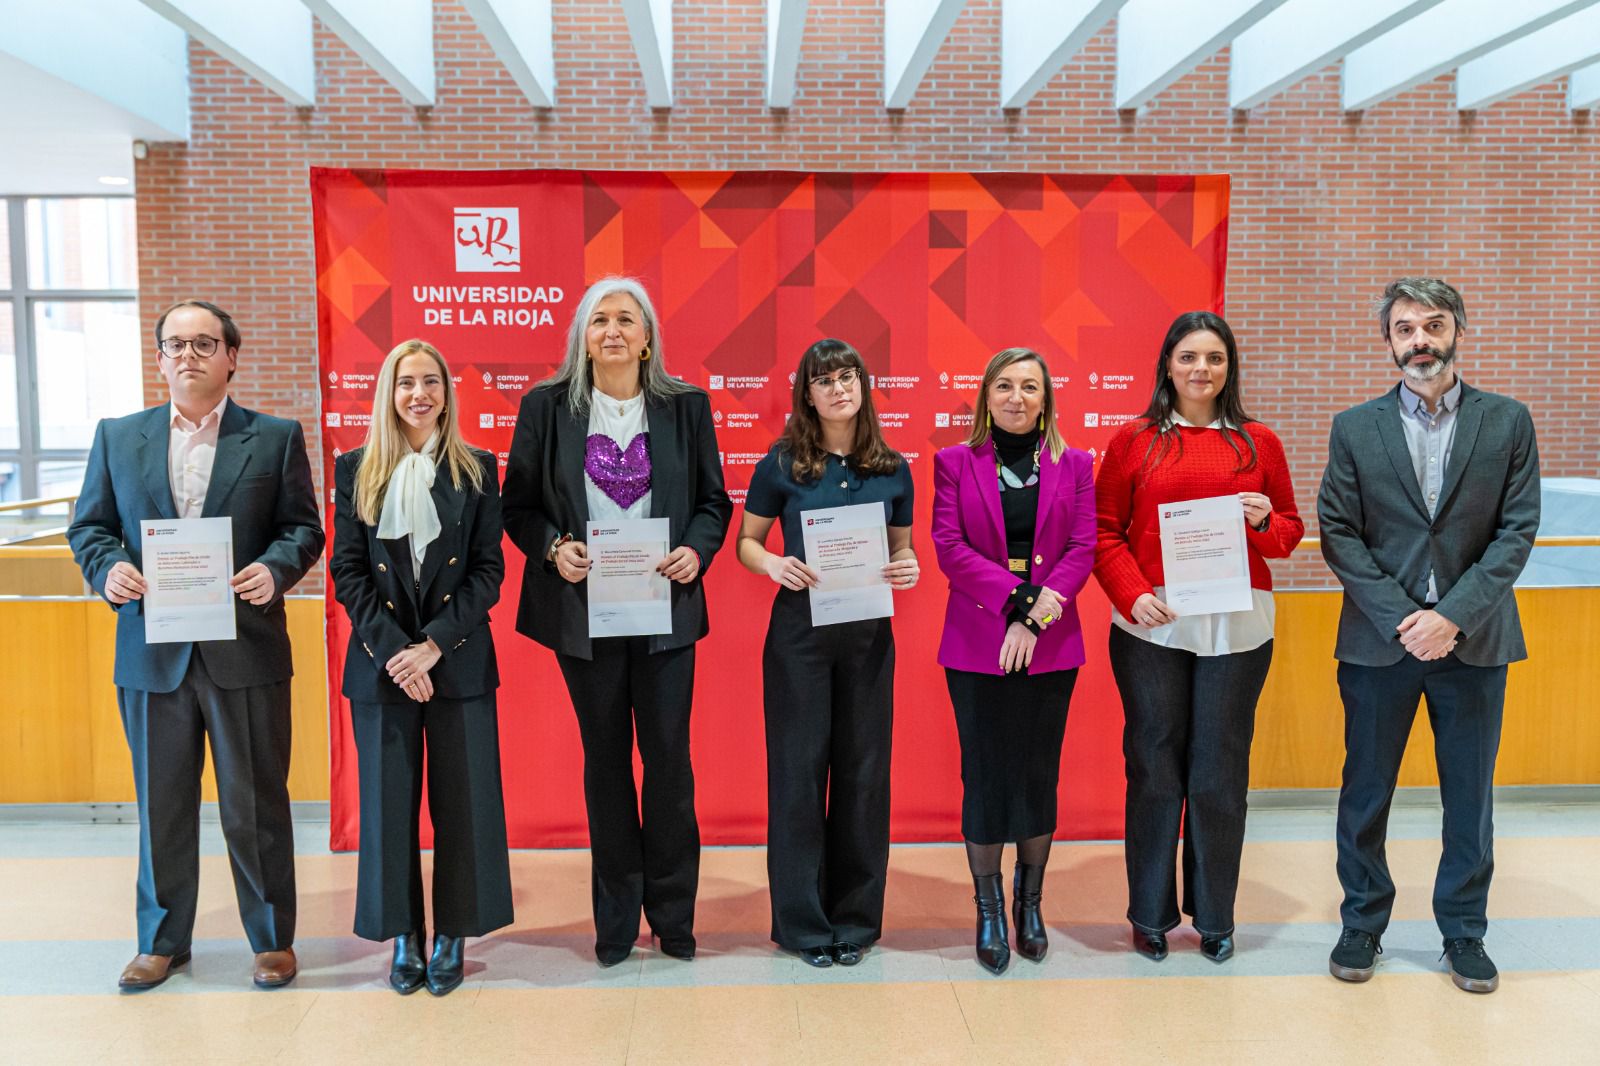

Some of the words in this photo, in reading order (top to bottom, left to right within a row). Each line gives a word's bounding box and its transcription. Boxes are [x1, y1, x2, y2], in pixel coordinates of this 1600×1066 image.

[413, 286, 564, 304] UNIVERSIDAD
[424, 309, 453, 326] DE
[459, 309, 487, 326] LA
[493, 309, 554, 330] RIOJA
[342, 374, 375, 382] campus
[496, 374, 529, 382] campus
[342, 381, 368, 389] iberus
[496, 382, 522, 390] iberus
